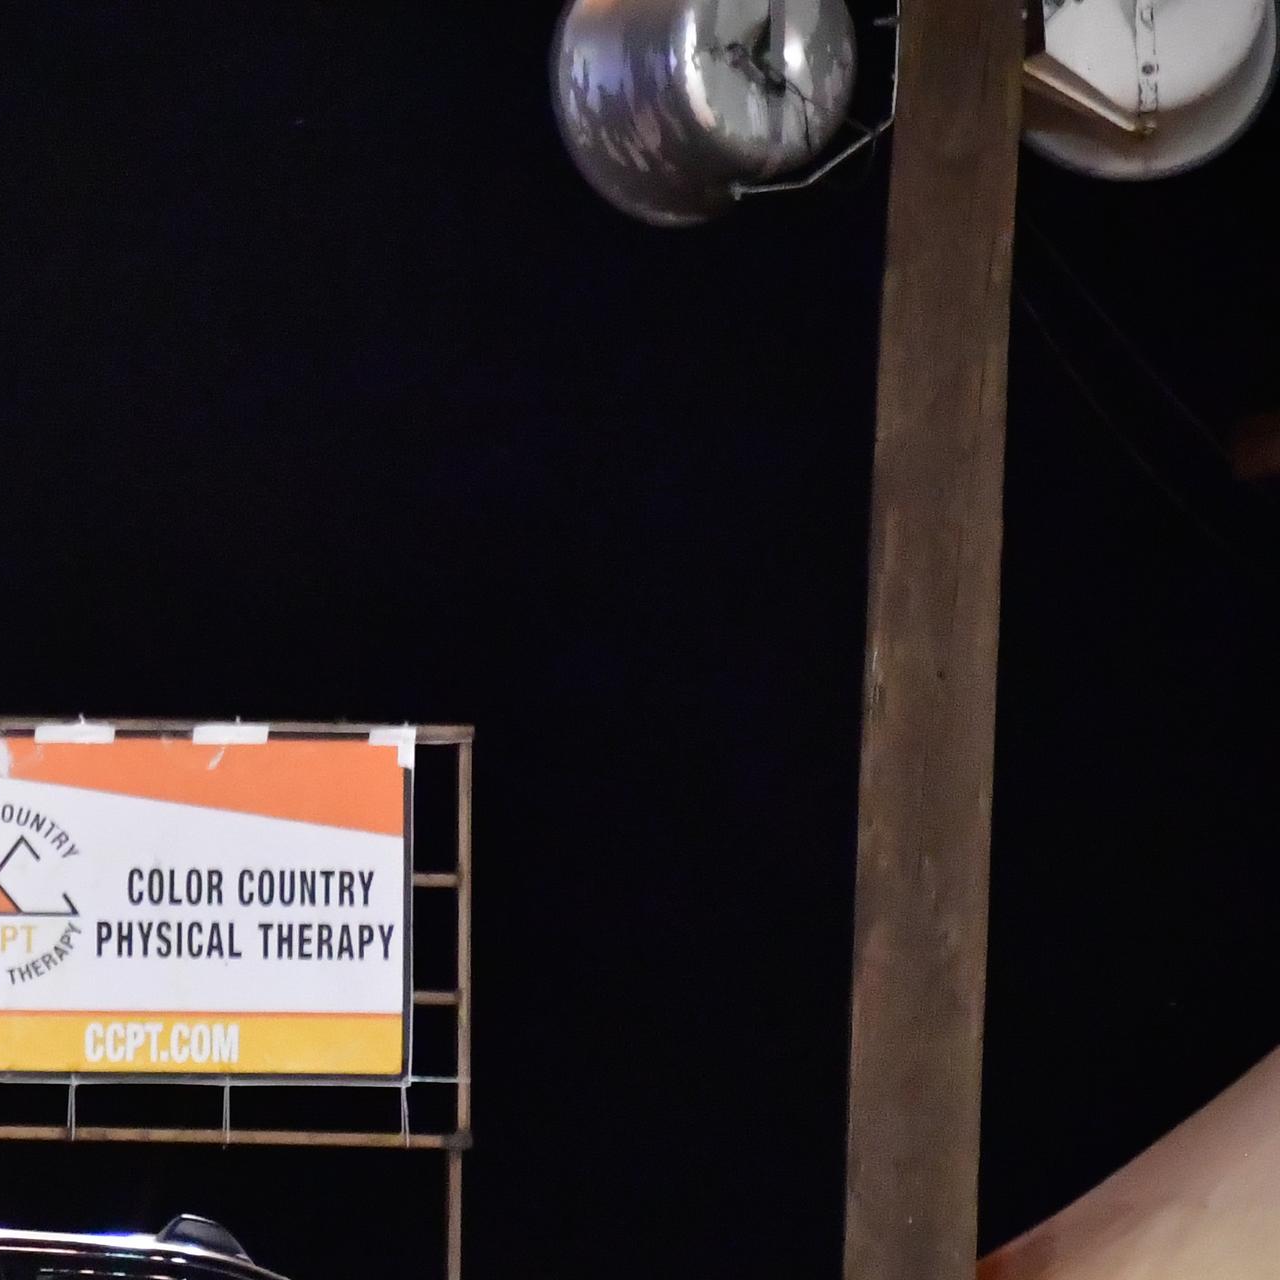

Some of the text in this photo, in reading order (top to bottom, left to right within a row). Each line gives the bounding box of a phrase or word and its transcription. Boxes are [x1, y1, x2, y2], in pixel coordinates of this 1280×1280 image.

[127, 868, 374, 908] COLOR COUNTRY
[7, 921, 82, 985] THERAPY
[96, 921, 395, 961] PHYSICAL THERAPY
[84, 1022, 240, 1064] CCPT.COM
